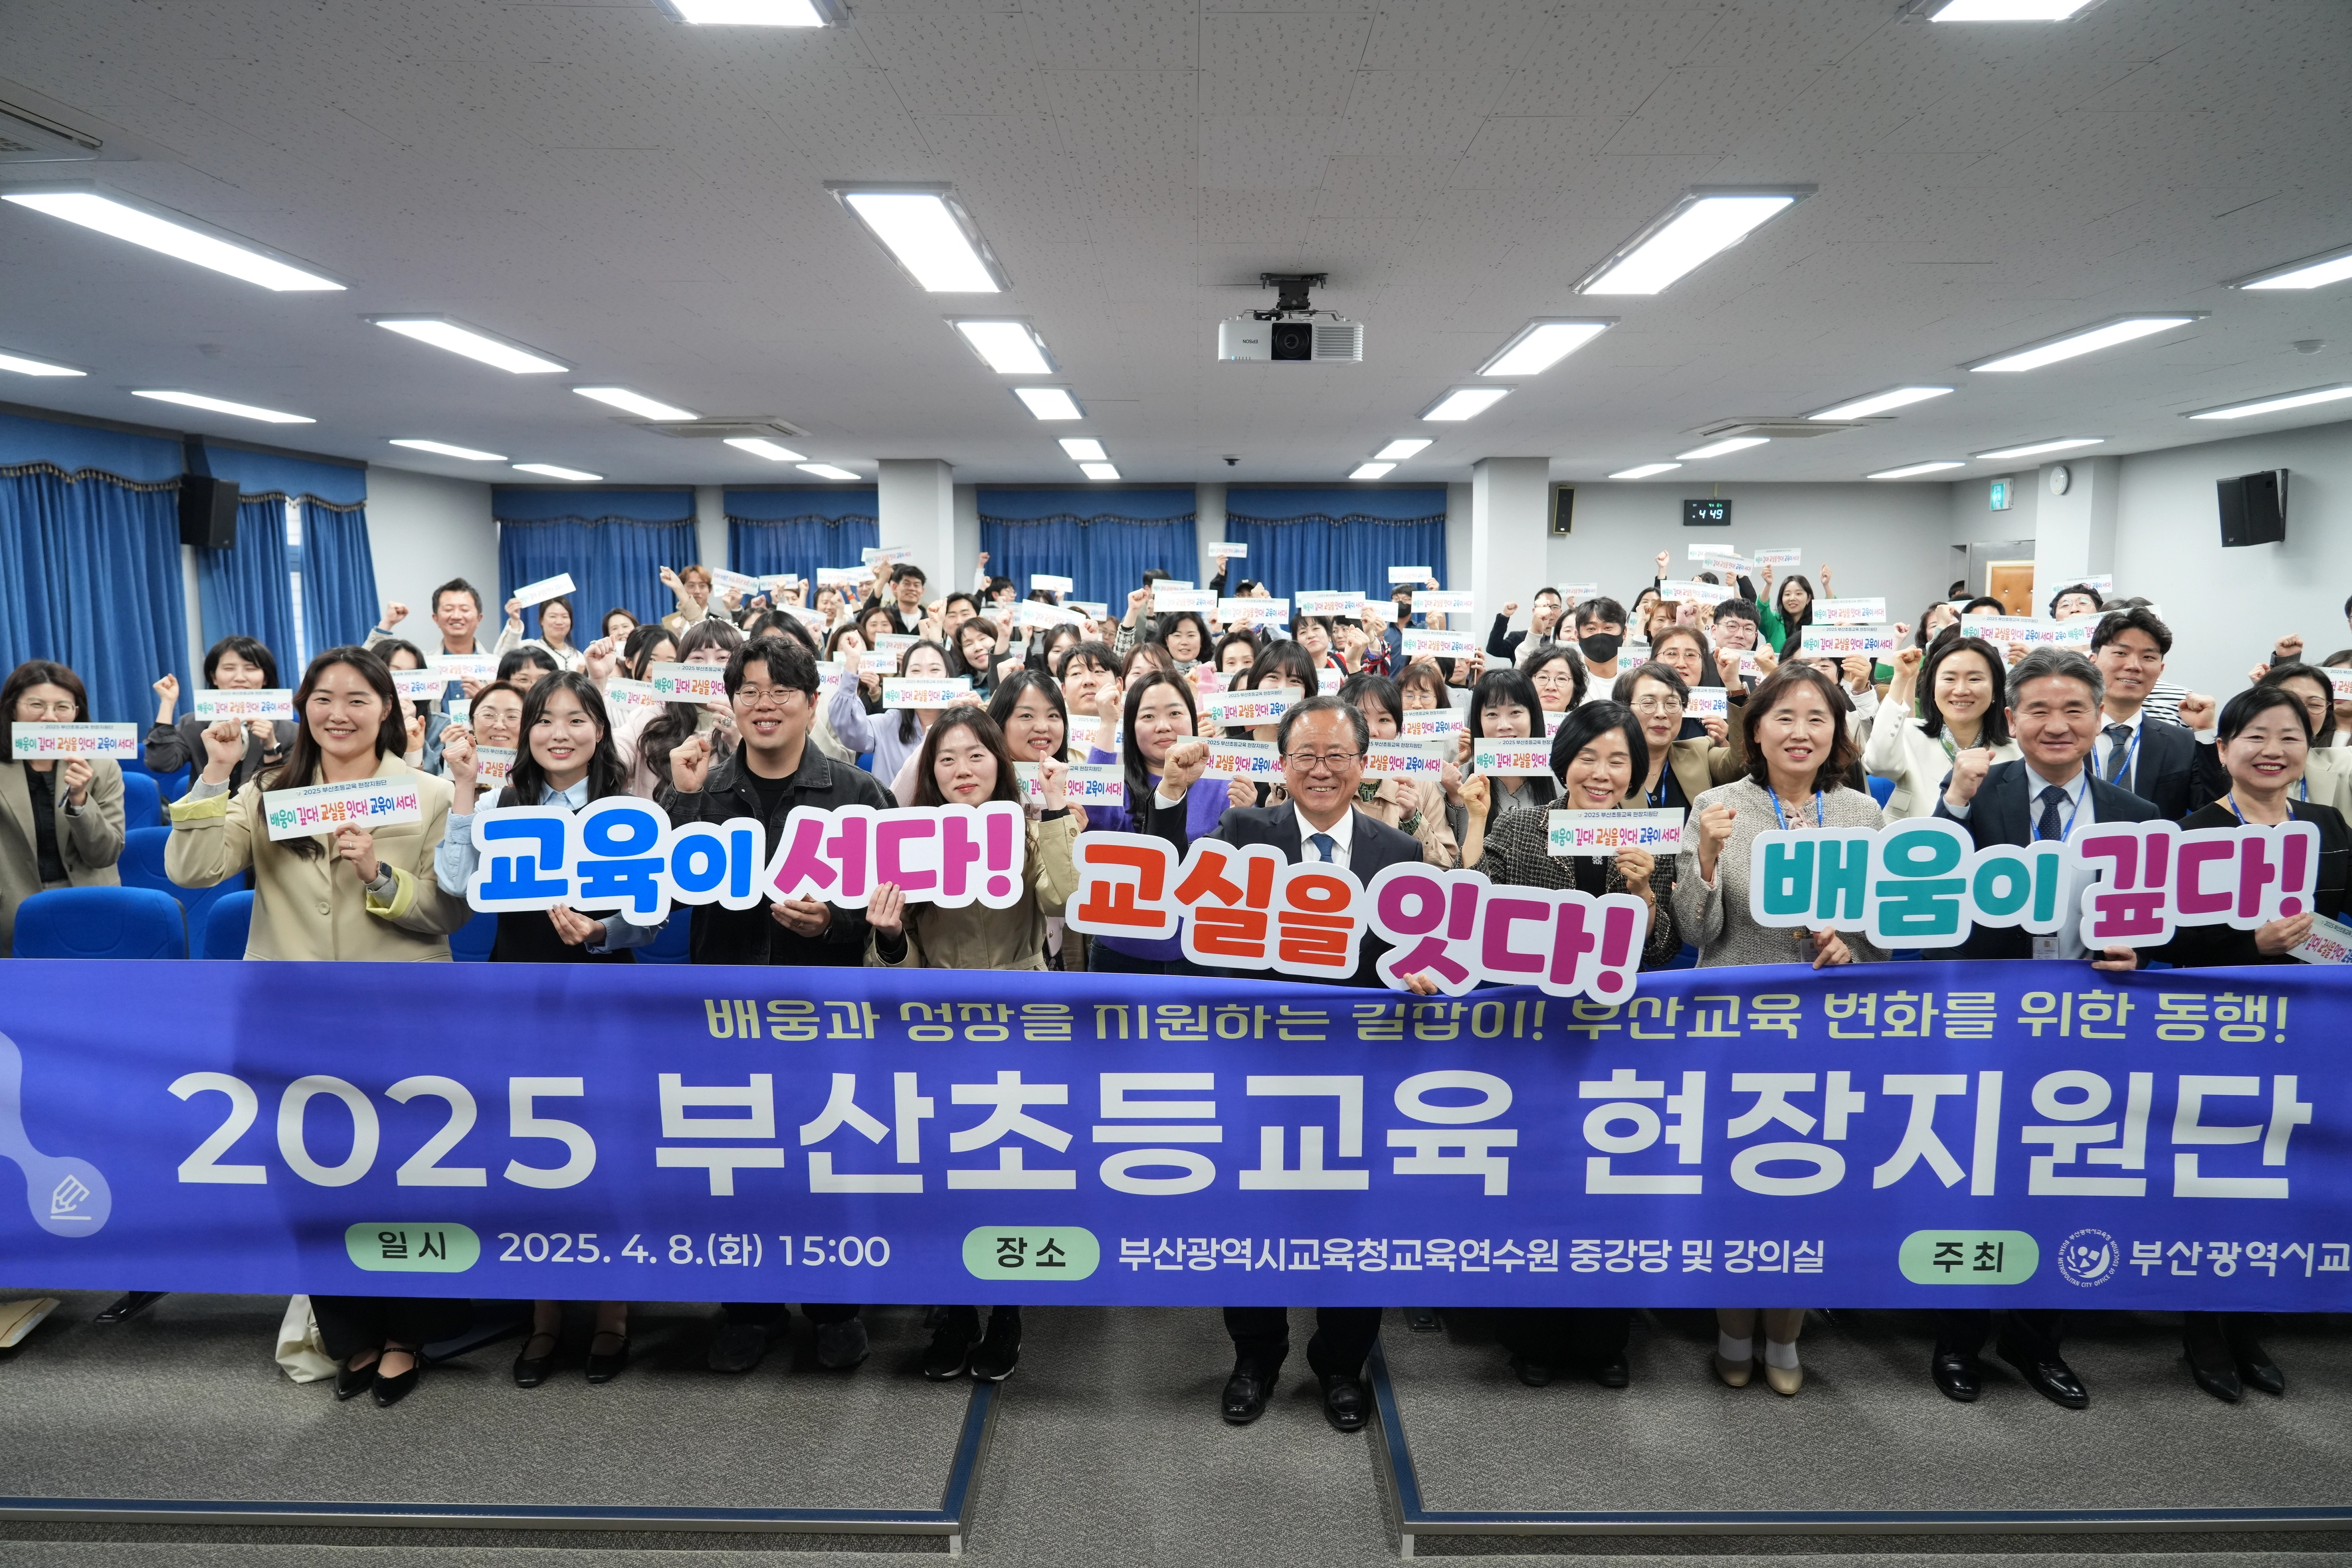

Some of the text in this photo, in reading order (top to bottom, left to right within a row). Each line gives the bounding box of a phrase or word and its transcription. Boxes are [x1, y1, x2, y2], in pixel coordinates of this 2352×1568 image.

[1699, 509, 1723, 519] 4 49
[1303, 603, 1314, 611] 배움이
[1315, 603, 1323, 611] 깊다!
[1324, 602, 1334, 610] 교실을
[1814, 610, 1826, 619] 배움이
[1828, 609, 1837, 618] 깊다!
[1839, 609, 1850, 618] 교실을
[1850, 609, 1860, 617] 잇다!
[1862, 608, 1873, 616] 교육이
[1994, 628, 2010, 640] 교실을
[2011, 628, 2023, 640] 잇다!
[2025, 630, 2039, 641] 교육이
[2040, 632, 2053, 642] 서다!
[1404, 639, 1416, 650] 배움이
[1417, 640, 1426, 650] 깊다!
[1428, 641, 1439, 651] 교실을
[1441, 641, 1450, 651] 잇다!
[1451, 642, 1463, 651] 교육이
[1803, 638, 1892, 650] 배움이 깊다! 교실을 잇다! 교육이 서다!
[654, 677, 710, 695] 배움이 깊다! 교실을
[611, 690, 640, 704] 배움이 깊다!
[886, 690, 955, 702] 배움이 깊다! 교실을 잇다! 교육이
[198, 703, 213, 714] 배움이
[215, 703, 228, 714] 깊다!
[230, 702, 245, 713] 교실을
[246, 702, 259, 713] 잇다!
[261, 702, 276, 711] 교육이
[1224, 703, 1285, 719] 깊다! 교실을 잇다! 교육이
[1699, 699, 1711, 710] 잇다!
[1071, 729, 1083, 741] 깊다!
[1407, 721, 1463, 735] 교실을 잇다! 교육이 서다!
[15, 737, 134, 751] 배움이 깊다! 교실을 잇다! 교육이 서다!
[1215, 755, 1269, 773] 교실을 잇다! 교육이
[1370, 755, 1440, 772] 교실을 잇다! 교육이 서다!
[1477, 753, 1546, 768] 배움이 깊다! 교실을 잇다!
[1068, 780, 1121, 797] 잇다! 교육이 서다!
[270, 794, 416, 829] 배움이 깊다! 교실을 잇다! 교육이 서다!
[1551, 827, 1679, 846] 배움이 깊다! 교실을 잇다! 교육이 서다!
[480, 809, 1011, 912] 교육이 서다!
[1765, 831, 2307, 937] 배움이 깊다!
[1079, 845, 1633, 992] 교실을 잇다!
[2305, 933, 2347, 962] 깊다! 교실을 잇다!
[704, 989, 2287, 1043] 배움과 성장을 지원하는 길잡이! 부산교육 변화를 위한 동행!
[168, 1069, 2312, 1198] 2025 부산초등교육 현장지원단
[2069, 1229, 2112, 1241] 부산광역시교육청
[498, 1233, 890, 1266] 2025. 4. 8.(화) 15:00
[1120, 1238, 1823, 1273] 부산광역시교육청교육연수원 중강당 및 강의실
[2058, 1240, 2070, 1256] BUSAN
[2110, 1241, 2119, 1266] EDUCATION
[2058, 1258, 2080, 1286] METROPOLITAN
[2094, 1275, 2110, 1286] OFFICE
